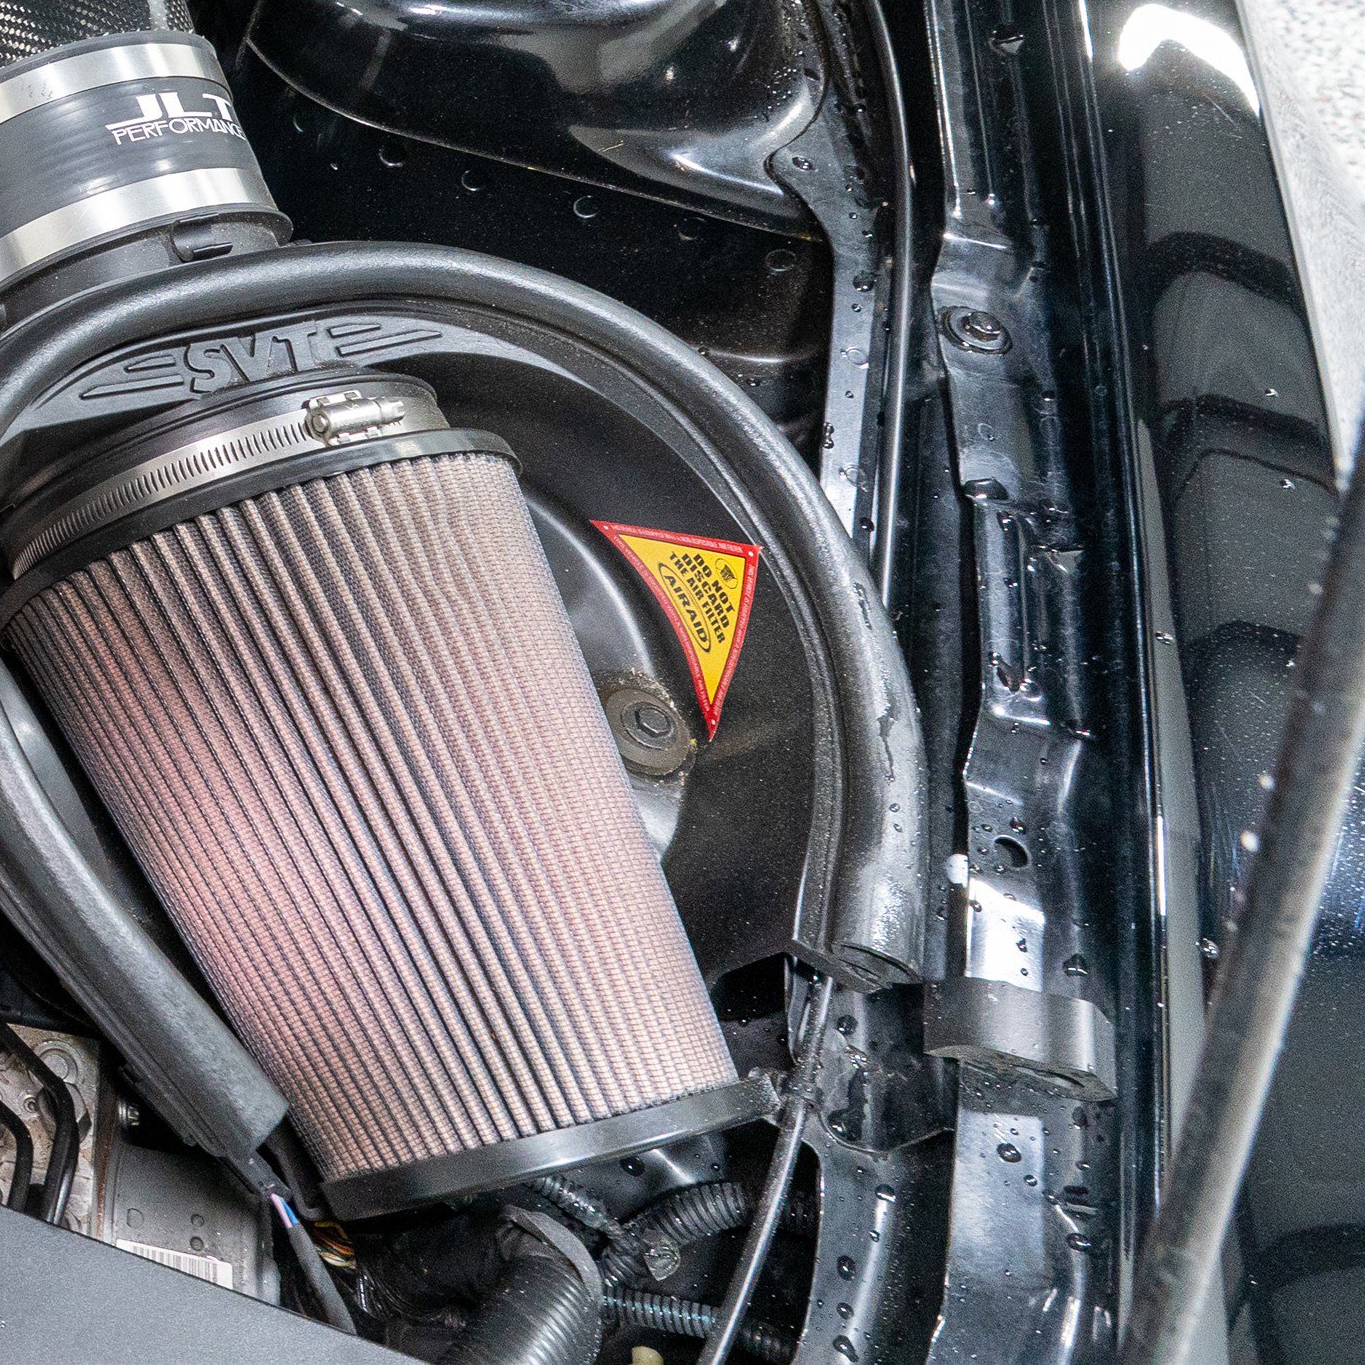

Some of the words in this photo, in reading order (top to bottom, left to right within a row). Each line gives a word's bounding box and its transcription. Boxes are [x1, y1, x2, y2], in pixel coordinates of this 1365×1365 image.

[105, 92, 234, 130] JLT
[112, 118, 247, 146] PERFORMANCE
[183, 321, 319, 394] SVT
[664, 574, 708, 643] AIRAID
[669, 551, 687, 577] THE
[687, 577, 704, 601] AIR
[702, 601, 726, 644] FILTER
[681, 553, 730, 629] DISCARD
[693, 553, 712, 579] DO
[711, 579, 736, 614] NOT
